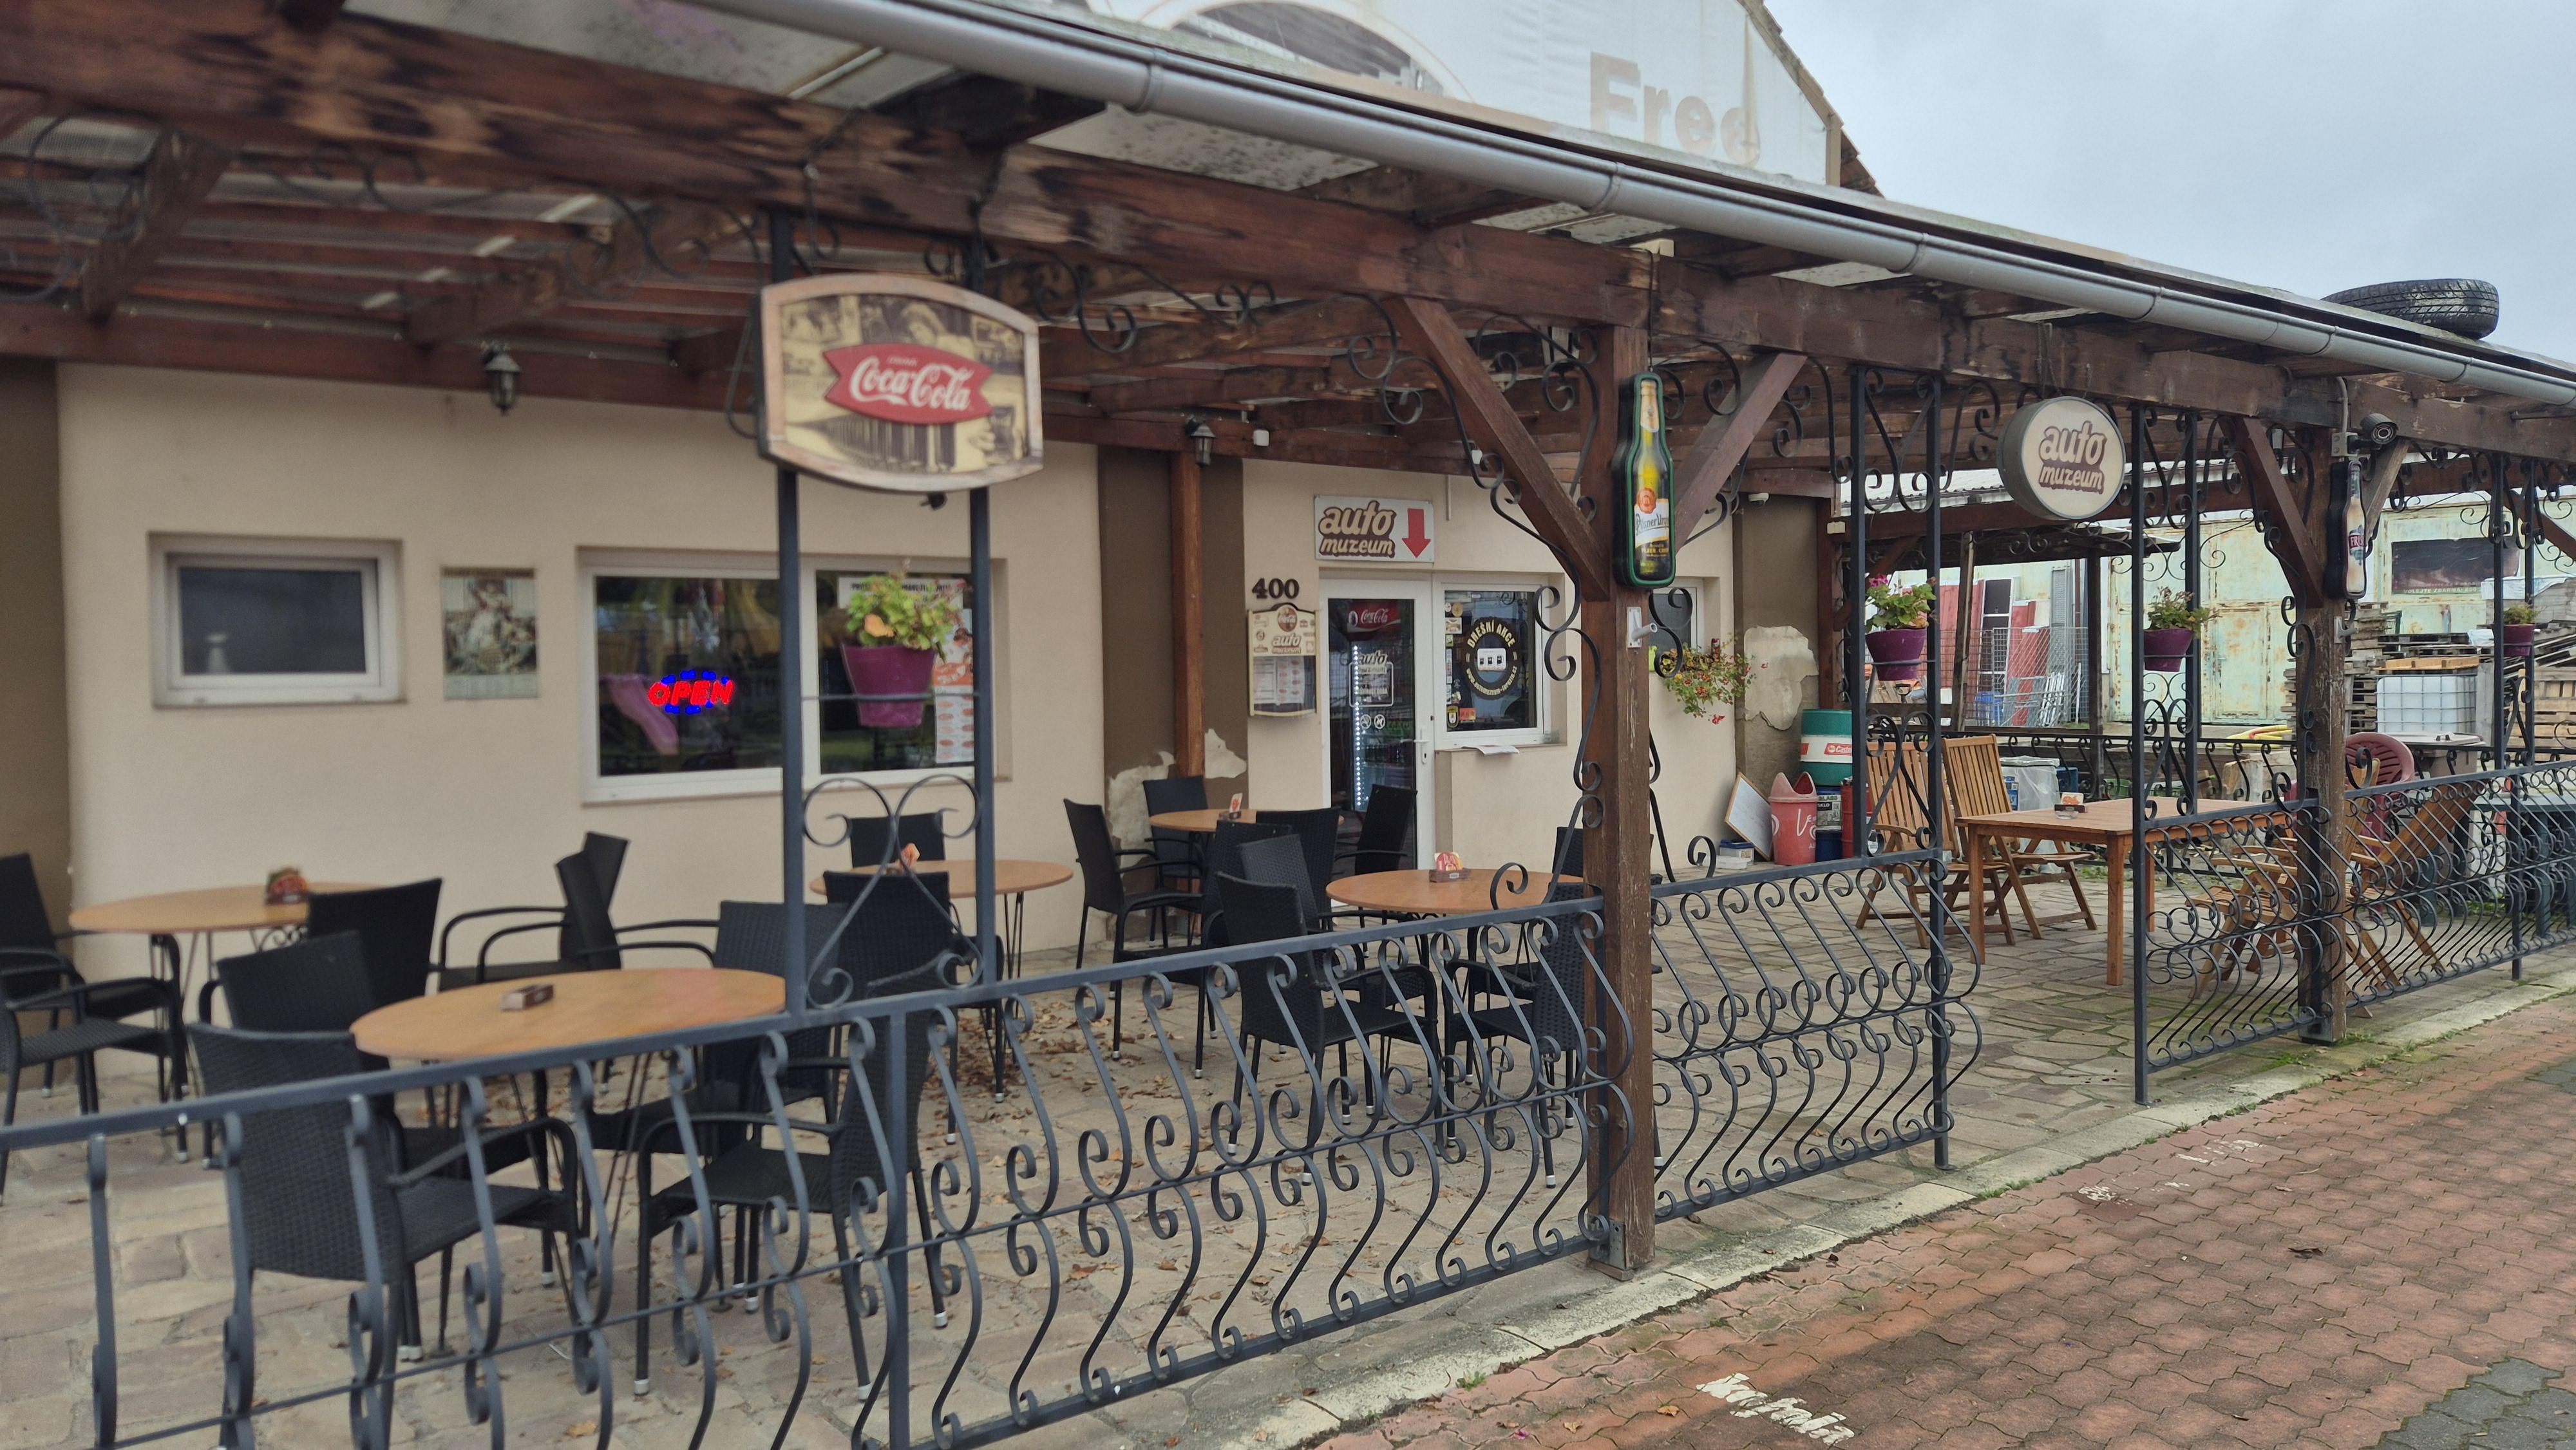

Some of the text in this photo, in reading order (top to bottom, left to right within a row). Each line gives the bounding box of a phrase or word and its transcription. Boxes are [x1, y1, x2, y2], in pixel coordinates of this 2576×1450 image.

[850, 356, 974, 411] Coca-Cola
[2040, 421, 2107, 465] auto
[2040, 466, 2104, 493] muzeum
[1318, 500, 1397, 537] auto
[1318, 536, 1396, 558] muzeum
[1252, 578, 1300, 599] 400
[1271, 632, 1302, 647] auto
[1467, 619, 1516, 648] DNEŠNÍ AKCE
[648, 680, 735, 706] OPEN
